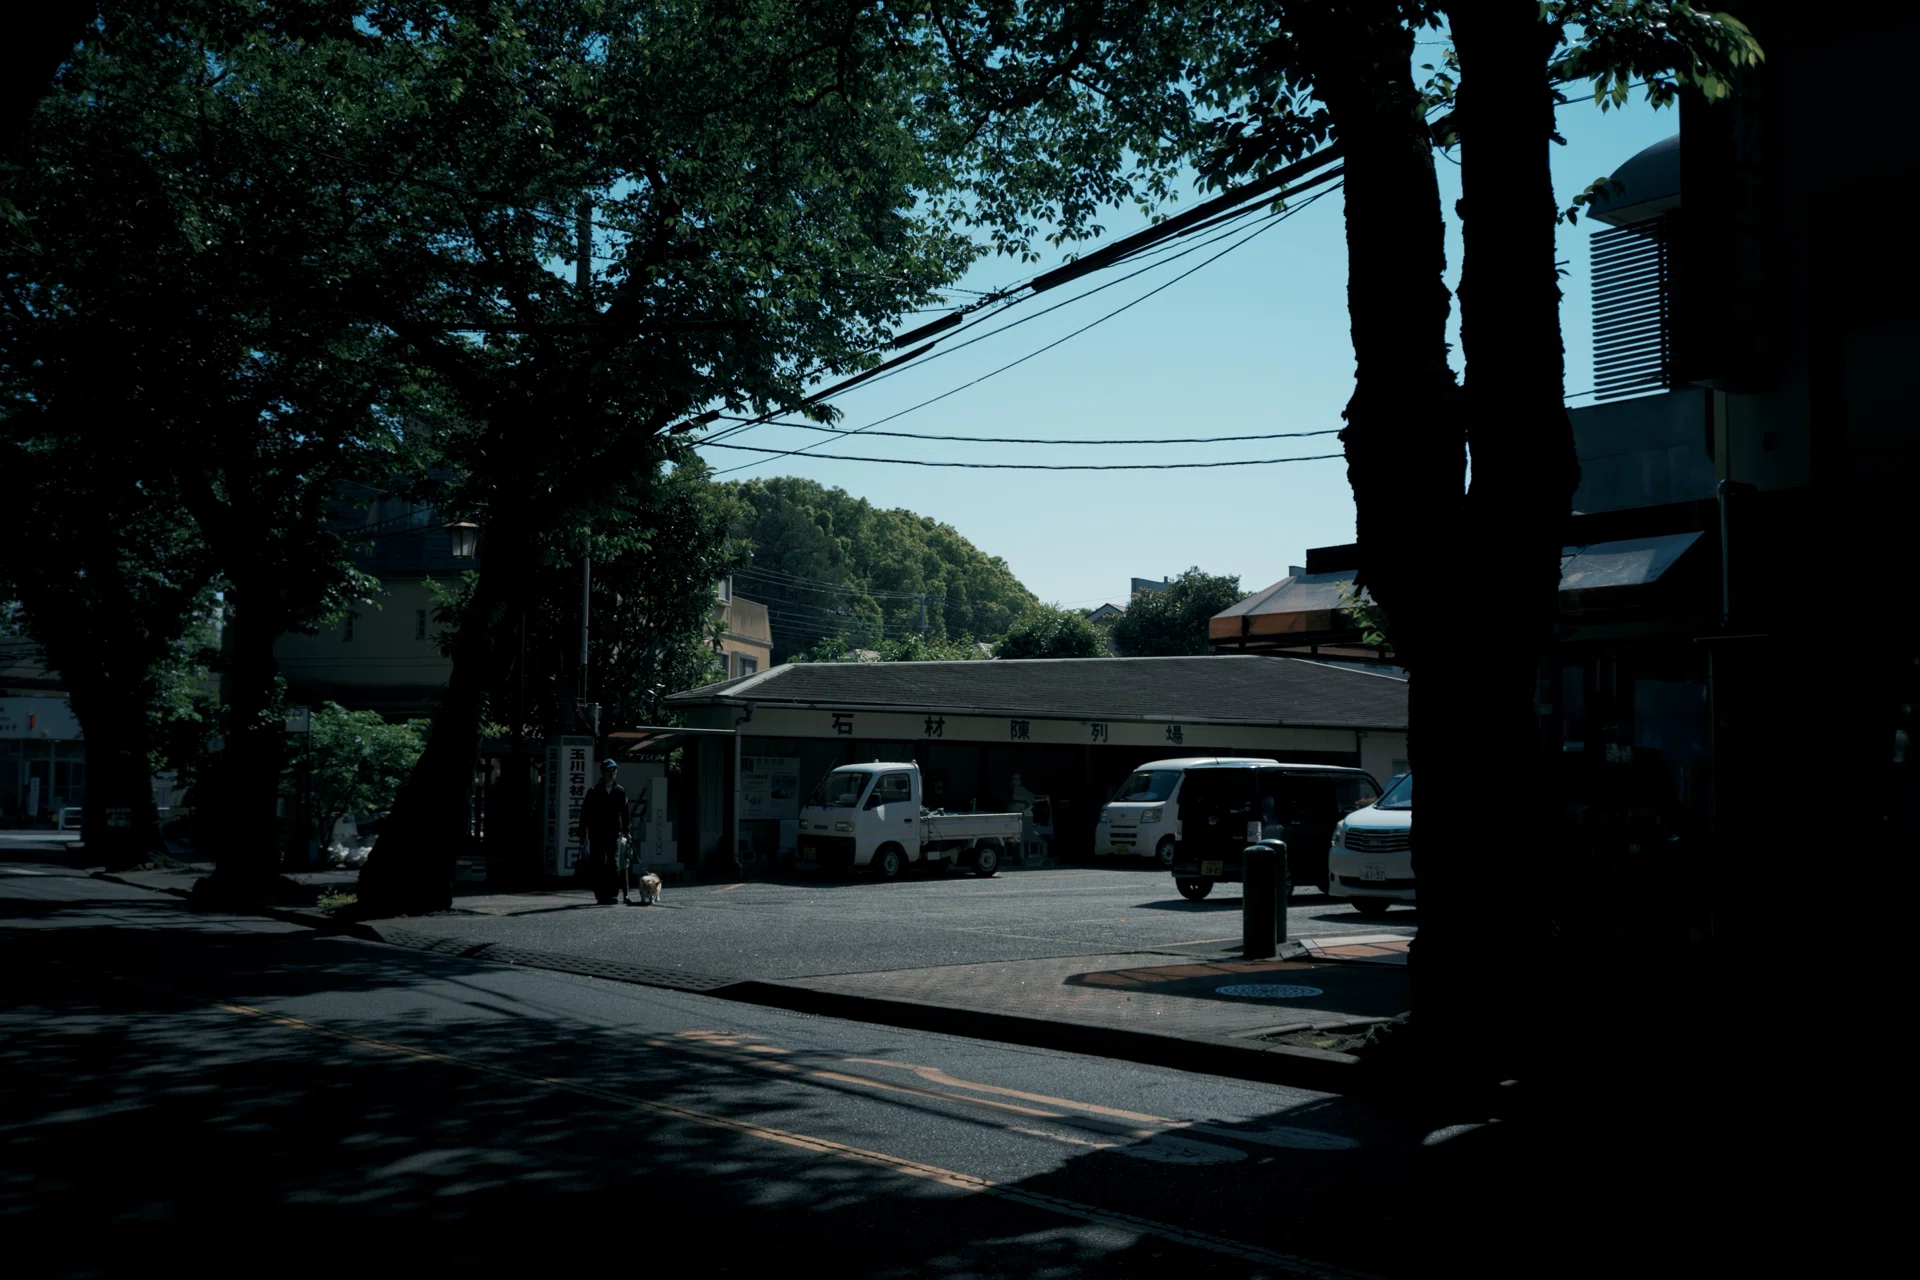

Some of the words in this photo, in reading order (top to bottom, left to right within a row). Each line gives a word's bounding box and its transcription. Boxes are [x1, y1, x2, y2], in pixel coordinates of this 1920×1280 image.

[831, 712, 1183, 745] 石材陳列場
